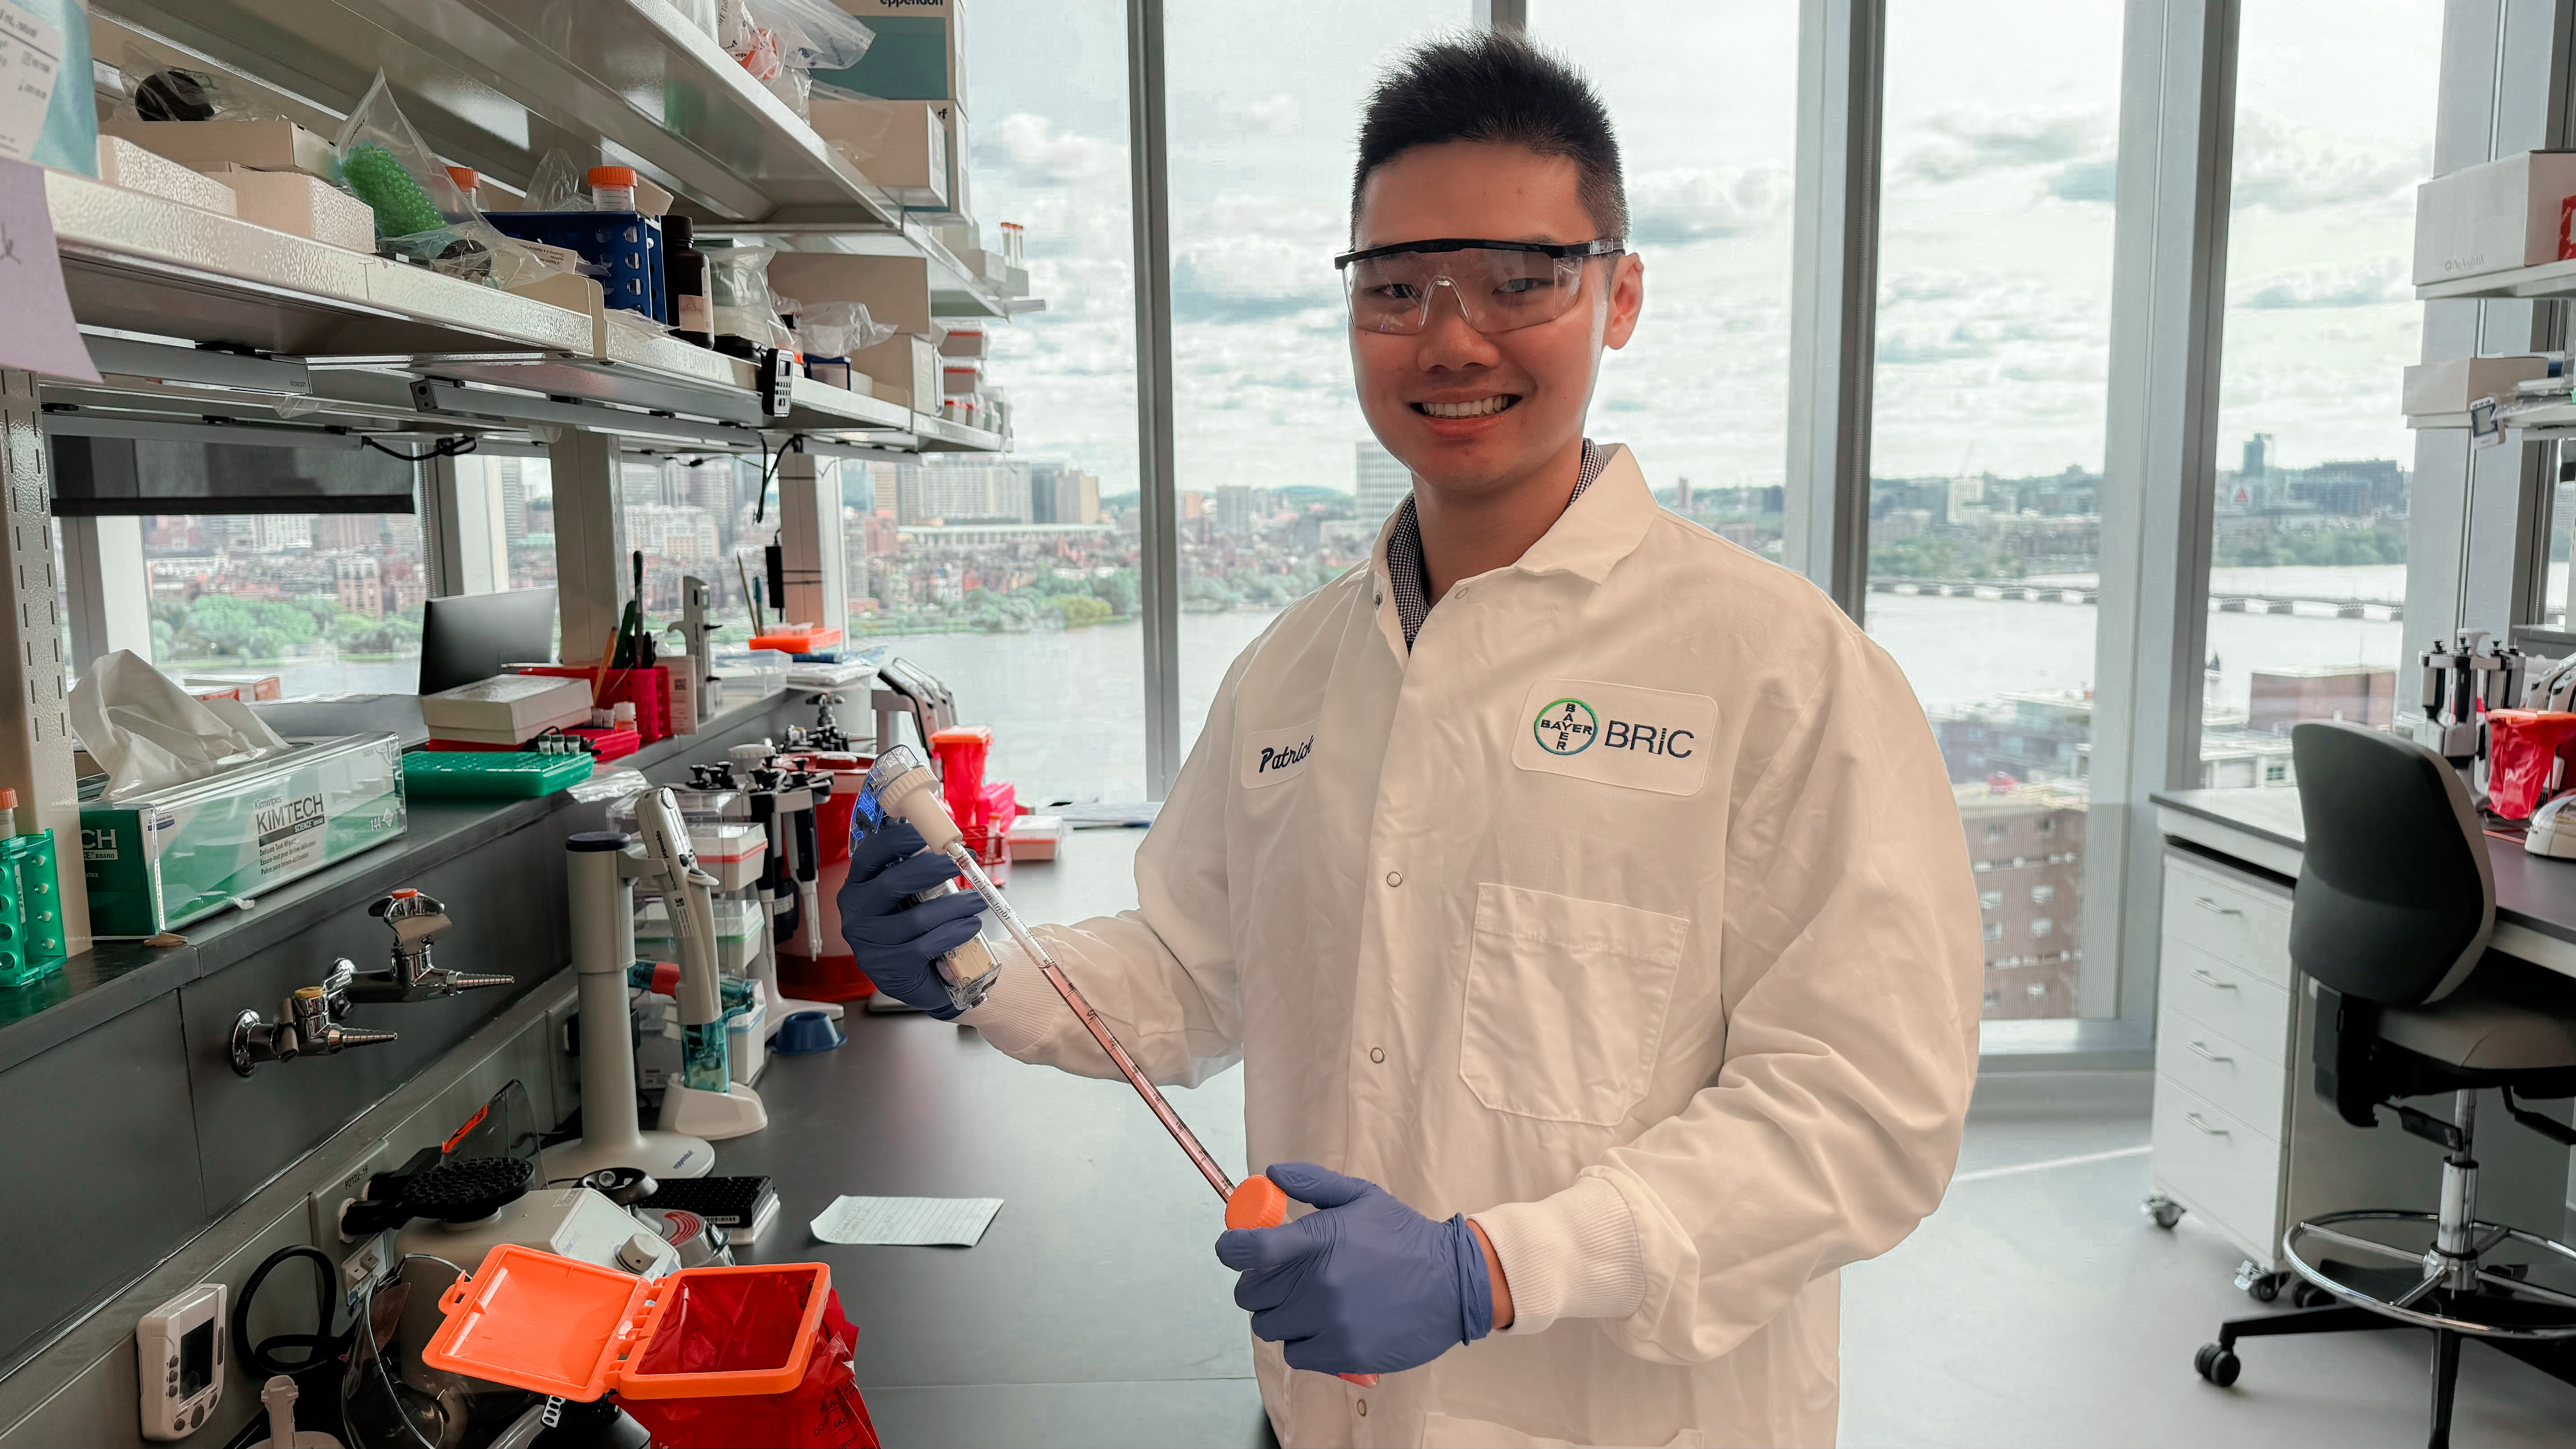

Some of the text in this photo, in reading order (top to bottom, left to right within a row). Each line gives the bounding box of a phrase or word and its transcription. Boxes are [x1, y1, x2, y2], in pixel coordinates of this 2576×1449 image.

[1540, 719, 1593, 735] BAYER
[254, 795, 283, 810] Kimwipes
[256, 793, 324, 835] KIMTECH
[345, 1165, 369, 1190] P2122-16
[813, 1423, 824, 1436] DO
[833, 1418, 846, 1428] DO
